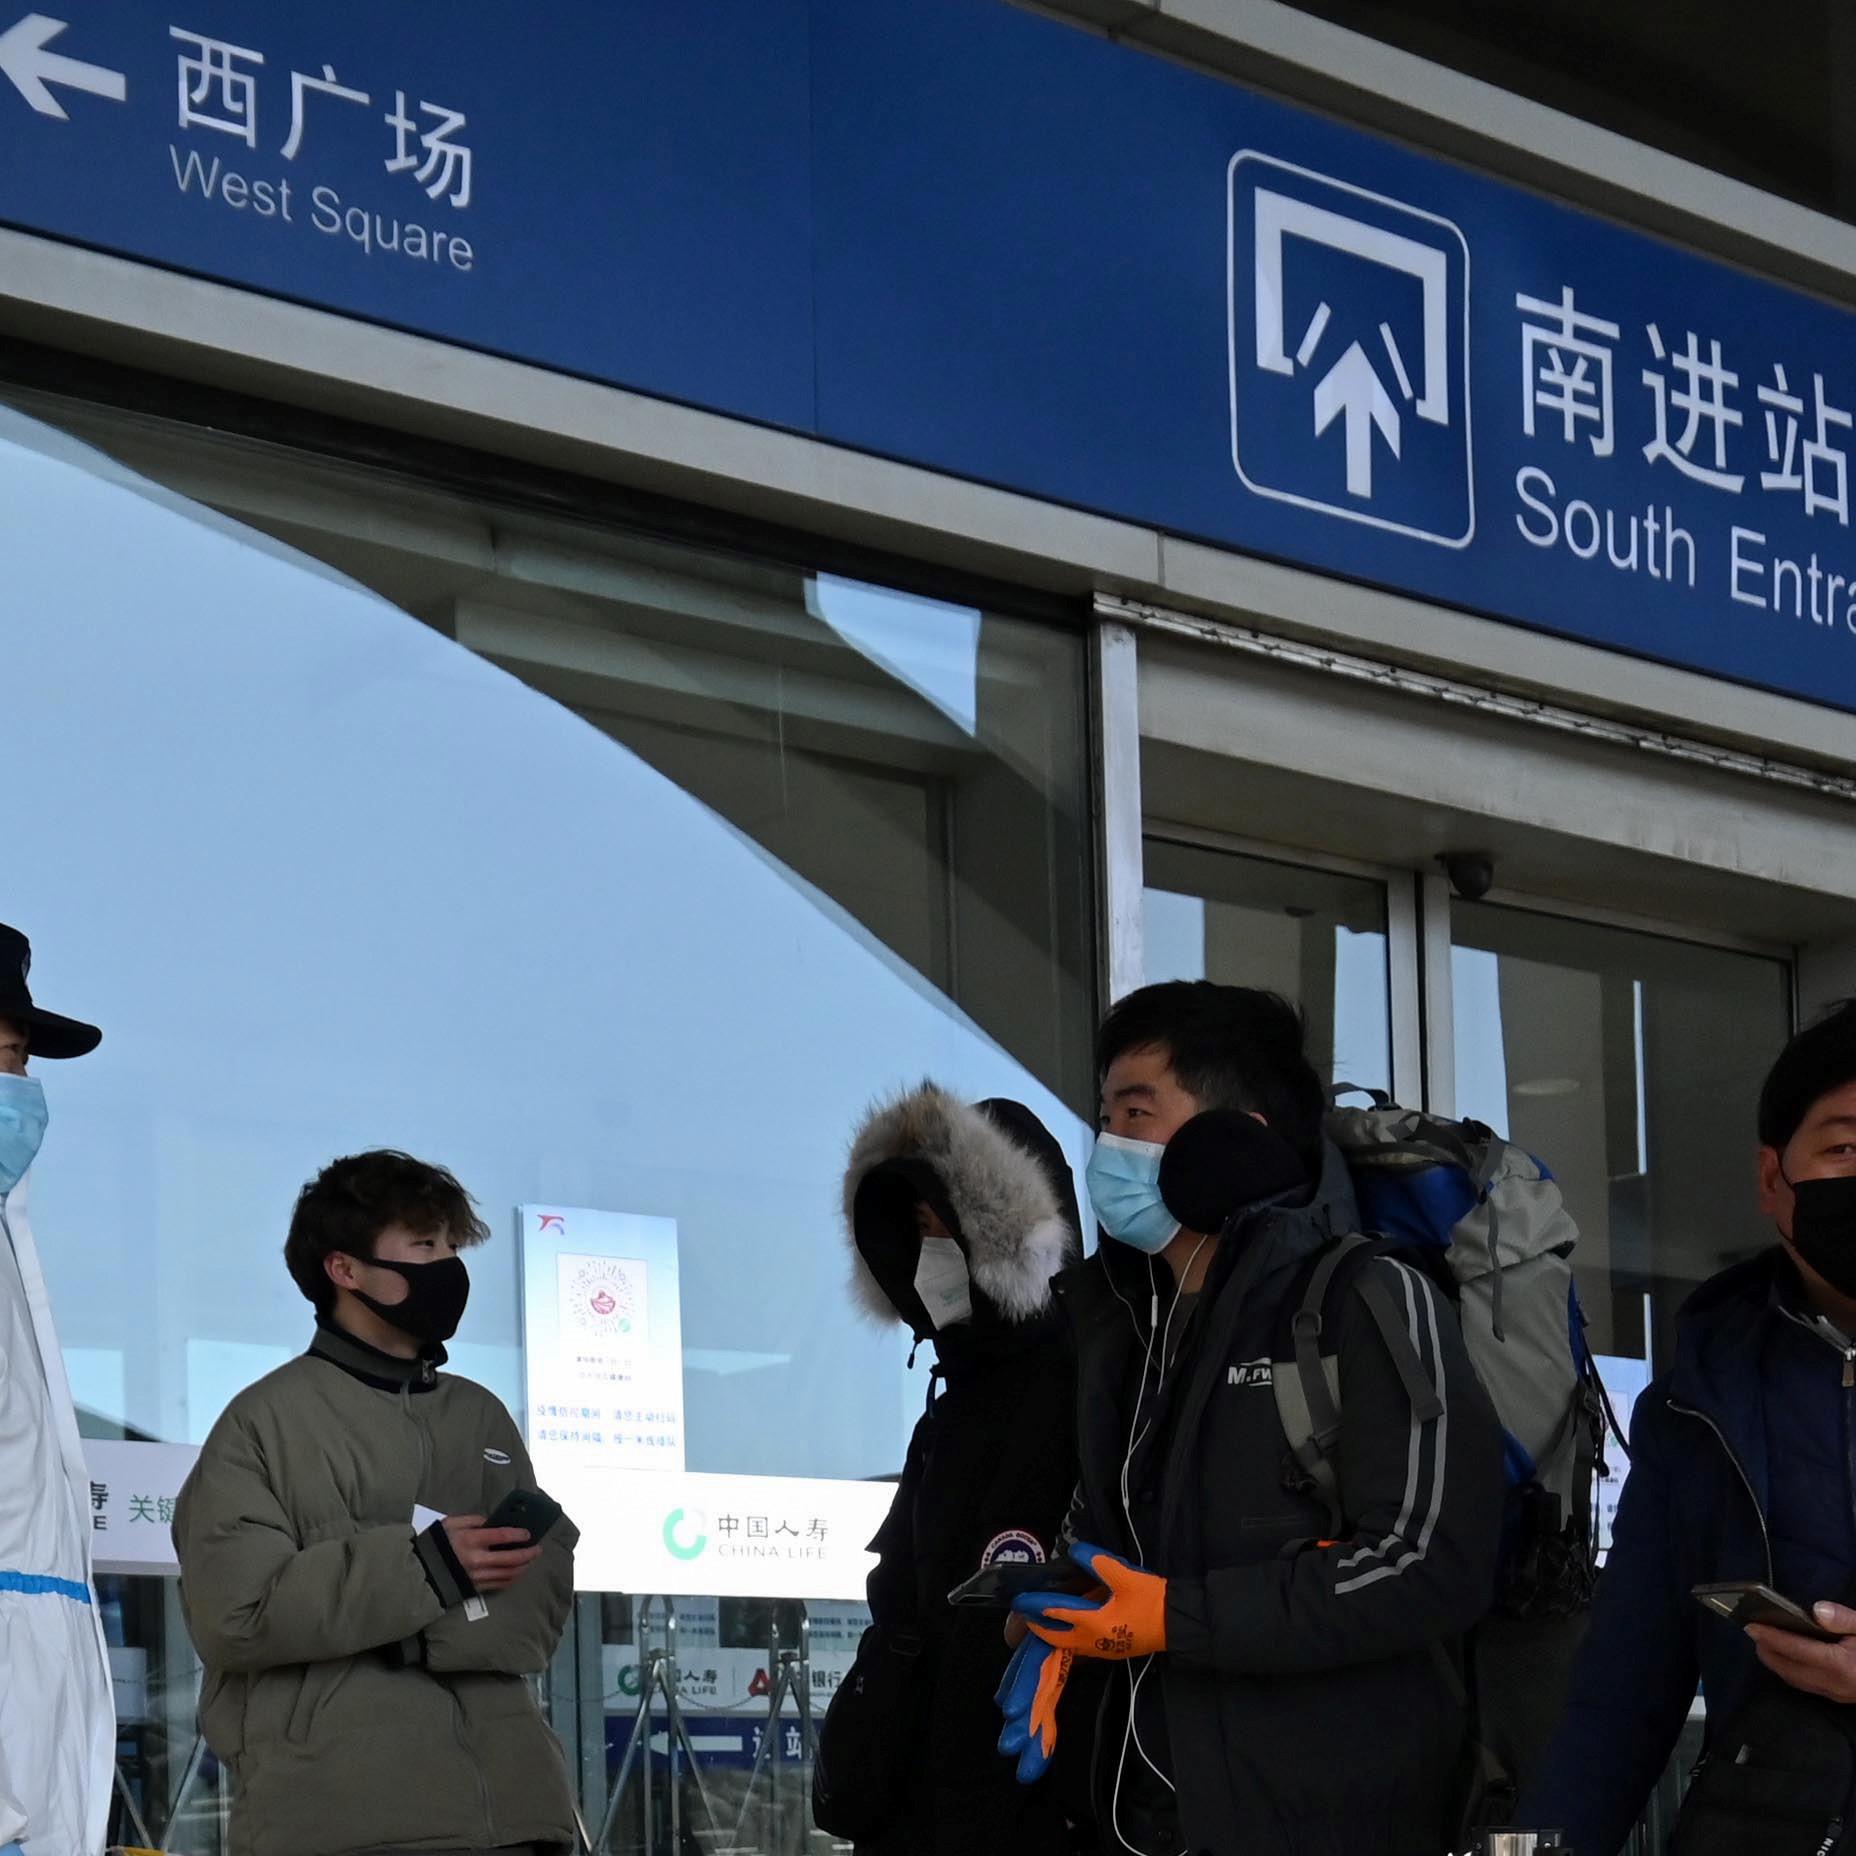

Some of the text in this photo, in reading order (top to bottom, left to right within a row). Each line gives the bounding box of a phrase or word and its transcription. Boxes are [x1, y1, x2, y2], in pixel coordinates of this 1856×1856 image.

[169, 24, 472, 207] 西广场
[169, 143, 474, 271] West Square
[1515, 465, 1697, 587] South
[718, 1513, 828, 1542] 中国人寿
[719, 1544, 826, 1559] CHINA LIFE
